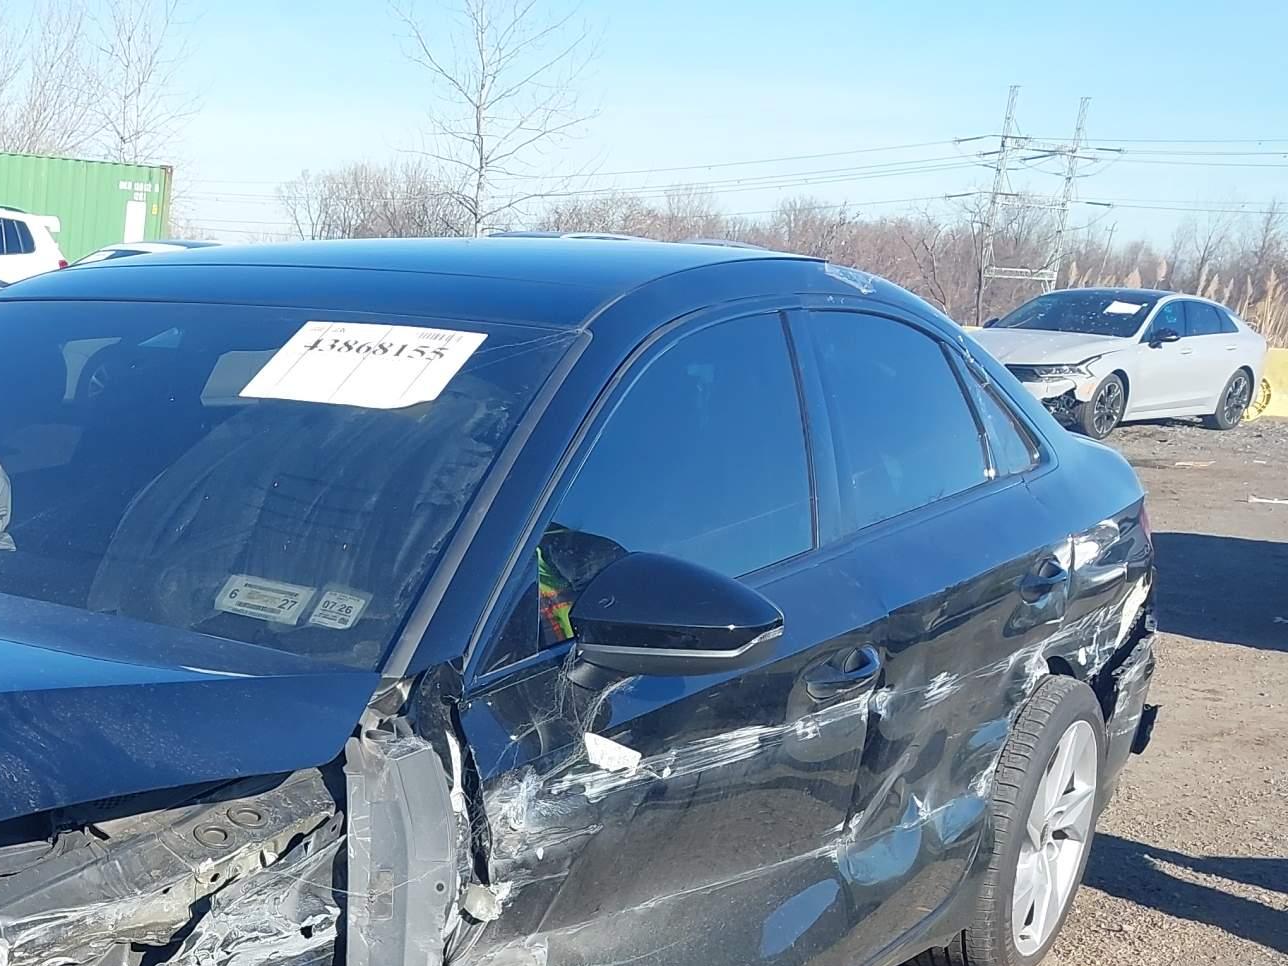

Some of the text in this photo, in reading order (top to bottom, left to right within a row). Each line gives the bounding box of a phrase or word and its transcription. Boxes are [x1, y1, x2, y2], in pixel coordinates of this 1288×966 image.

[304, 338, 448, 360] 43868155
[229, 588, 240, 599] 6
[277, 598, 298, 611] 27
